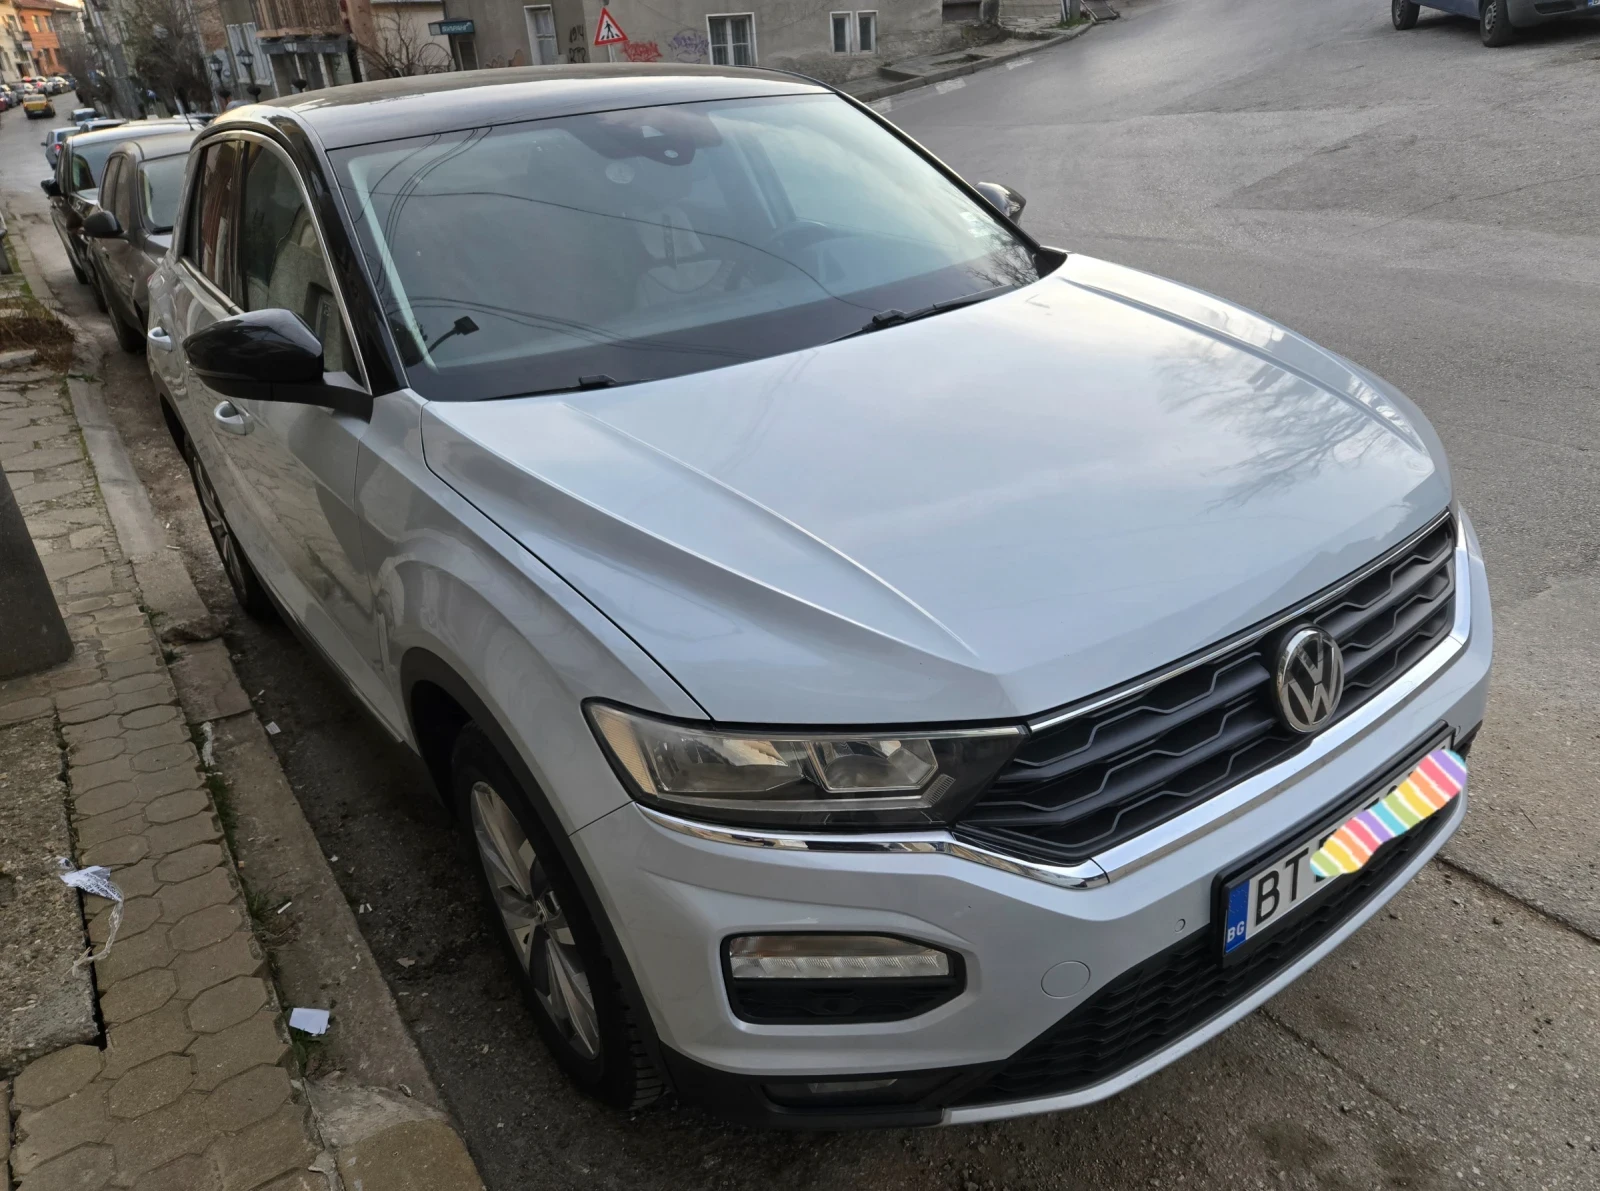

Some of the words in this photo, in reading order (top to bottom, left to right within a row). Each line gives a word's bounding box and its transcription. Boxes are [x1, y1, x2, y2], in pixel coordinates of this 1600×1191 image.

[1282, 635, 1341, 726] VW
[1255, 847, 1309, 927] BT
[1226, 920, 1245, 943] BG
